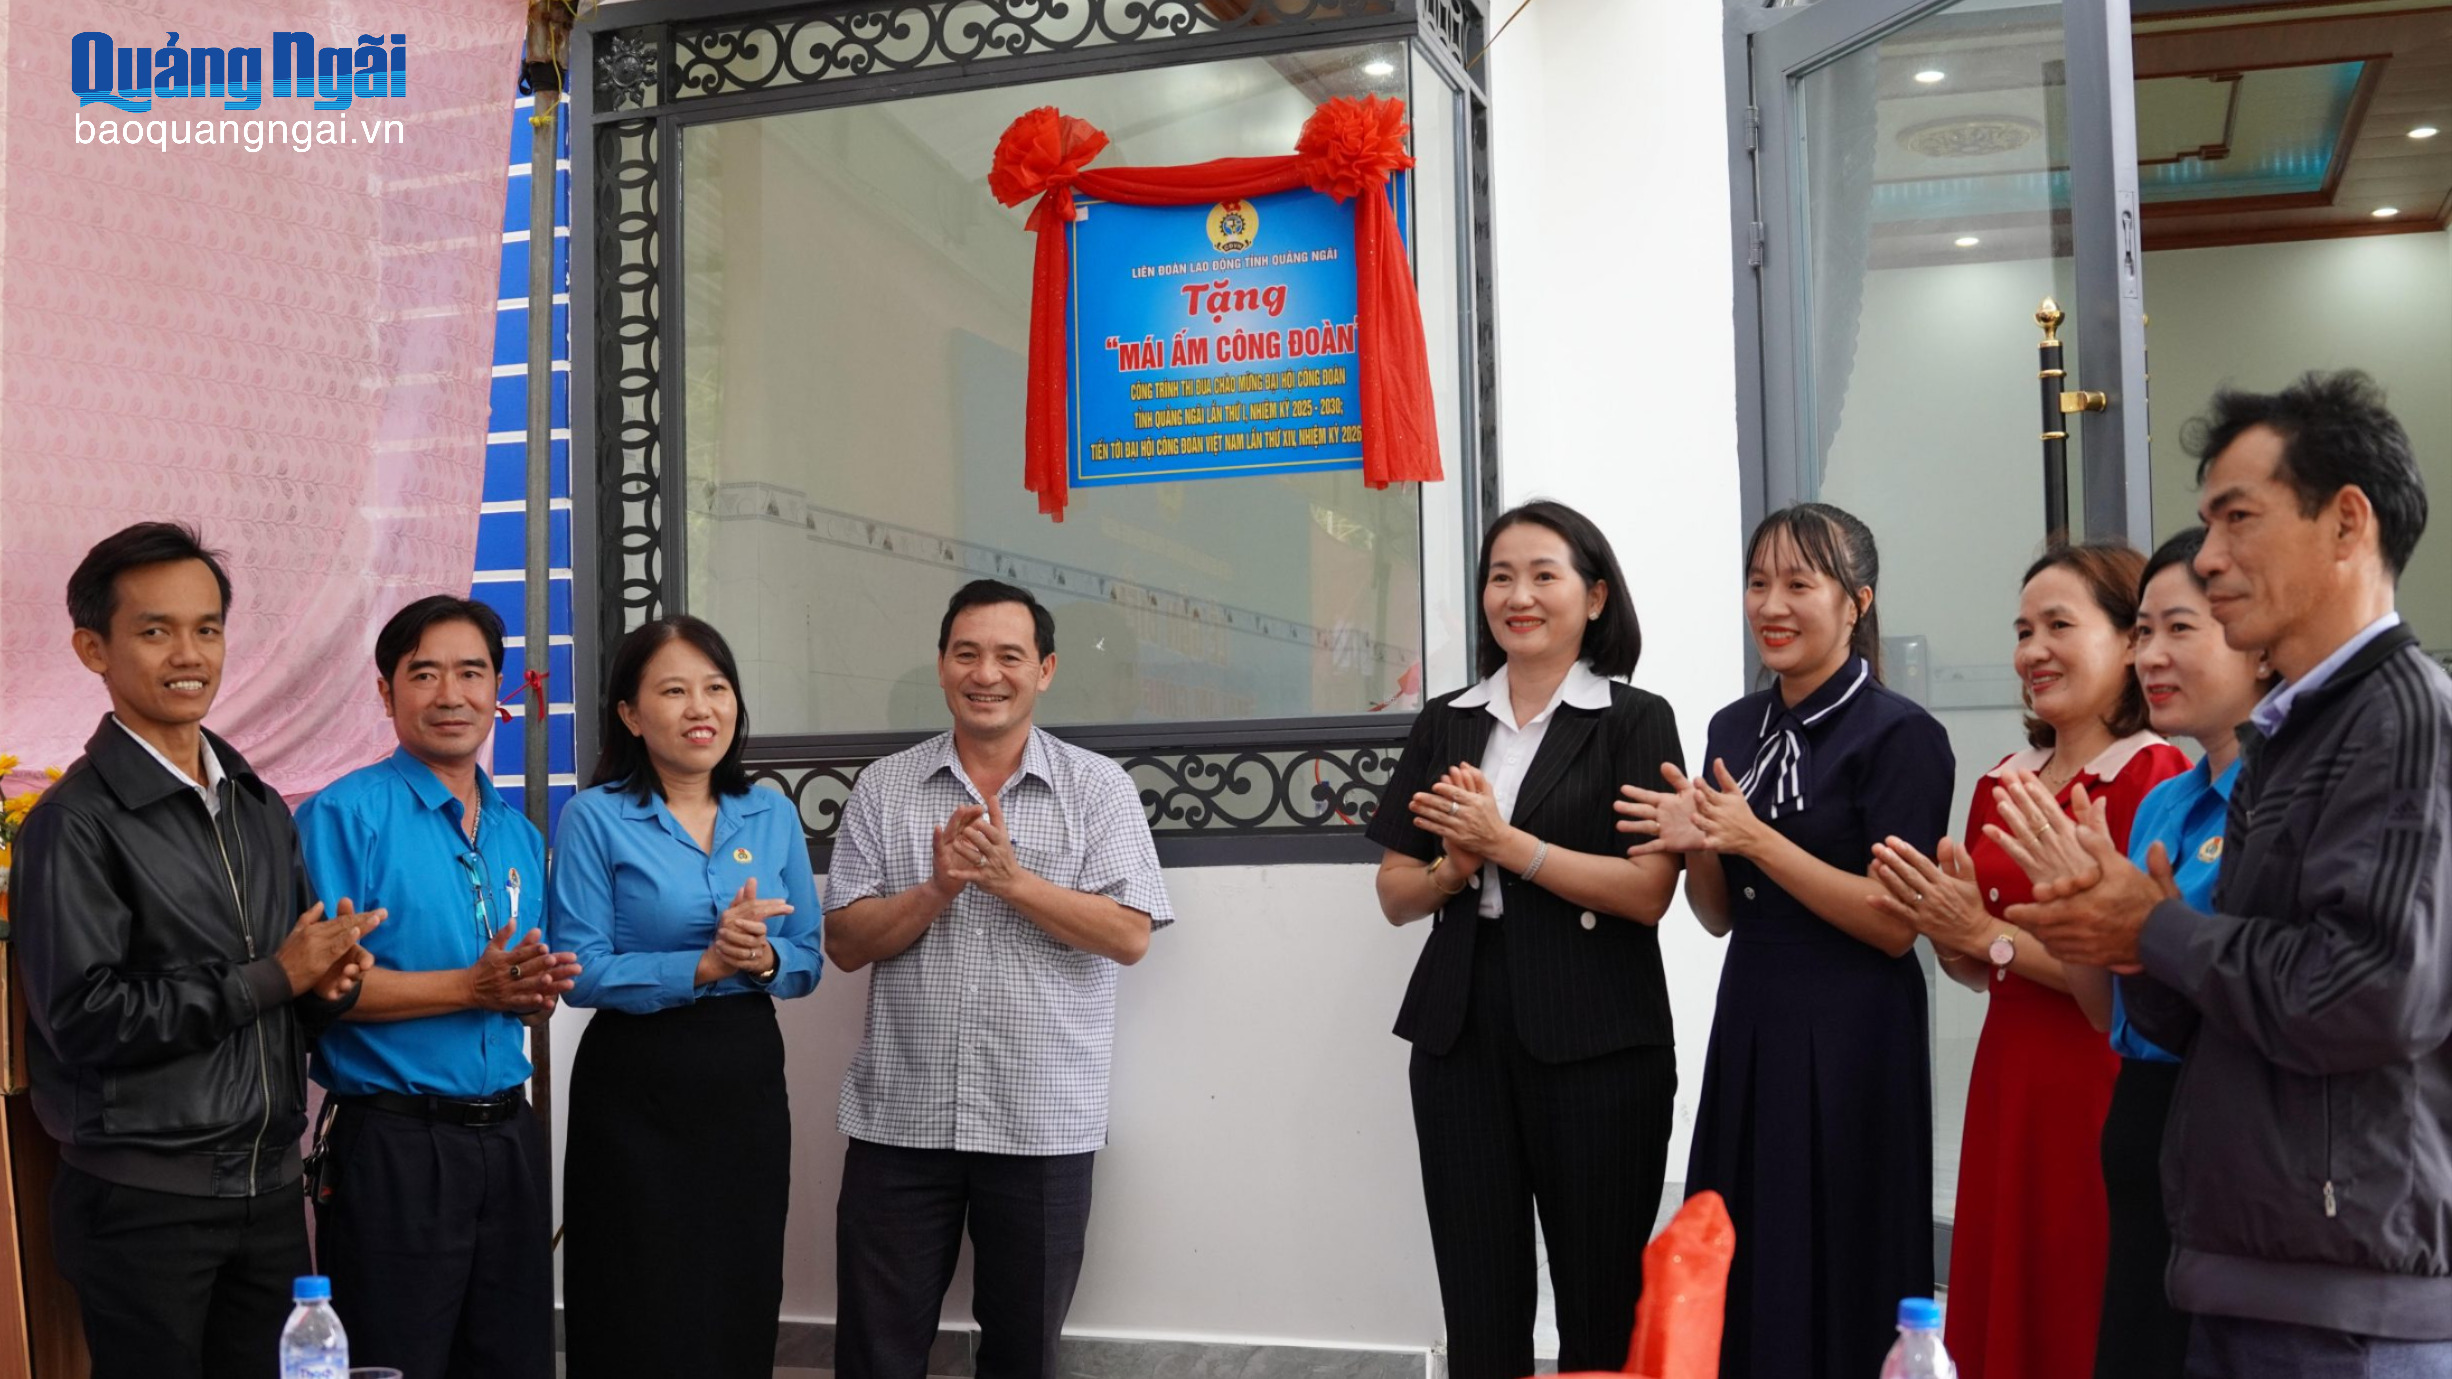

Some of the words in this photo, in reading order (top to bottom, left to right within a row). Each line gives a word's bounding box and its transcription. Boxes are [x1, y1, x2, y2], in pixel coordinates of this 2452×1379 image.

[1132, 265, 1155, 278] LIÊN
[1158, 262, 1187, 276] ĐOÀN
[1190, 261, 1209, 273] LAO
[1212, 257, 1242, 273] ĐỘNG
[1245, 253, 1269, 268] TỈNH
[1272, 250, 1308, 266] QUẢNG
[1311, 247, 1337, 261] NGÃI
[1181, 278, 1288, 324] Tặng
[1171, 327, 1209, 367] ẤM
[1216, 328, 1281, 363] CÔNG
[1130, 380, 1153, 400] CÔNG
[1155, 378, 1179, 399] TRÌNH
[1181, 380, 1194, 396] THI
[1196, 378, 1212, 396] ĐUA
[1214, 373, 1236, 394] CHÀO
[1238, 371, 1263, 392] MỪNG
[1265, 373, 1279, 394] ĐẠI
[1281, 368, 1295, 392] HỘI
[1297, 367, 1320, 388] CÔNG
[1322, 364, 1346, 386] ĐOÀN
[1134, 406, 1153, 429] TỈNH
[1155, 404, 1182, 429] QUẢNG
[1184, 403, 1205, 425] NGÃI
[1207, 400, 1222, 423] LẦN
[1225, 400, 1241, 422] THỨ
[1250, 399, 1277, 423] NHIỆM
[1279, 398, 1290, 418] KỲ
[1292, 399, 1312, 417] 2025
[1320, 397, 1344, 416] 2030;
[1091, 437, 1109, 461] TIẾN
[1111, 438, 1123, 459] TỚI
[1125, 440, 1138, 461] ĐẠI
[1141, 436, 1155, 460] HỘI
[1156, 435, 1179, 456] CÔNG
[1181, 432, 1204, 454] ĐOÀN
[1205, 431, 1222, 456] VIỆT
[1224, 433, 1244, 451] NAM
[1246, 426, 1263, 450] LẦN
[1264, 426, 1281, 448] THỨ
[1299, 423, 1327, 449] NHIỆM
[1328, 421, 1340, 444] KỲ
[1341, 425, 1362, 443] 2026
